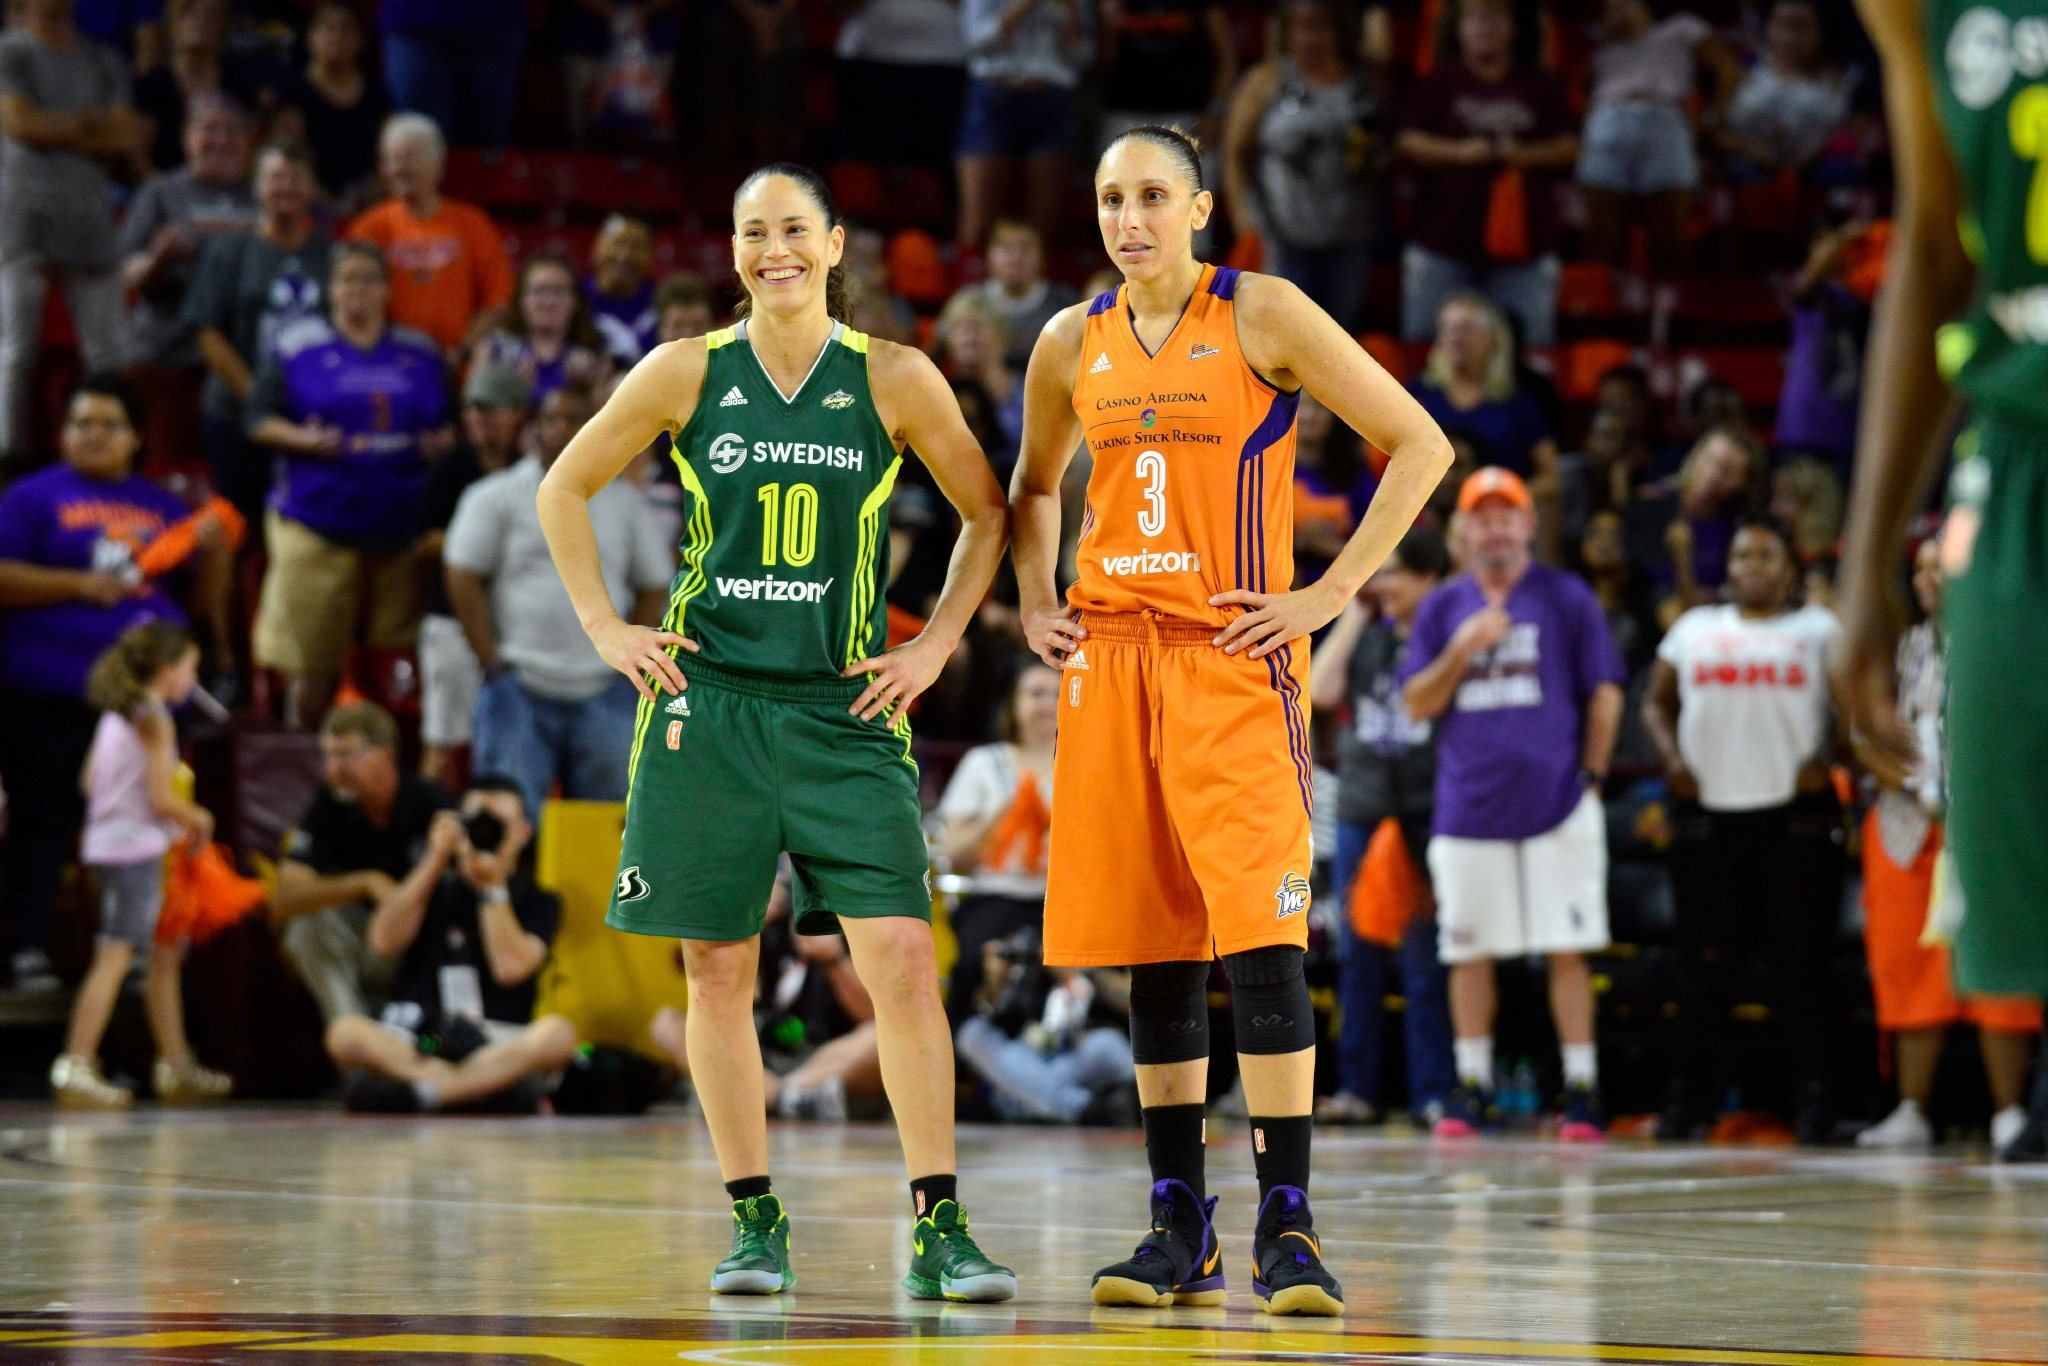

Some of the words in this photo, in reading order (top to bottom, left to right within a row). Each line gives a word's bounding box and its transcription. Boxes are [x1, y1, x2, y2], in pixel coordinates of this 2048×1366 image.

[720, 397, 749, 407] adidas
[1096, 396, 1141, 411] CASINO
[1145, 392, 1208, 405] ARIZONA
[1134, 431, 1170, 444] STICK
[1172, 429, 1222, 445] RESORT
[752, 441, 863, 472] SWEDISH
[1135, 450, 1166, 538] 3
[758, 482, 819, 567] 10
[1102, 547, 1201, 577] verizon
[715, 574, 821, 604] verizon
[664, 705, 691, 717] adidas
